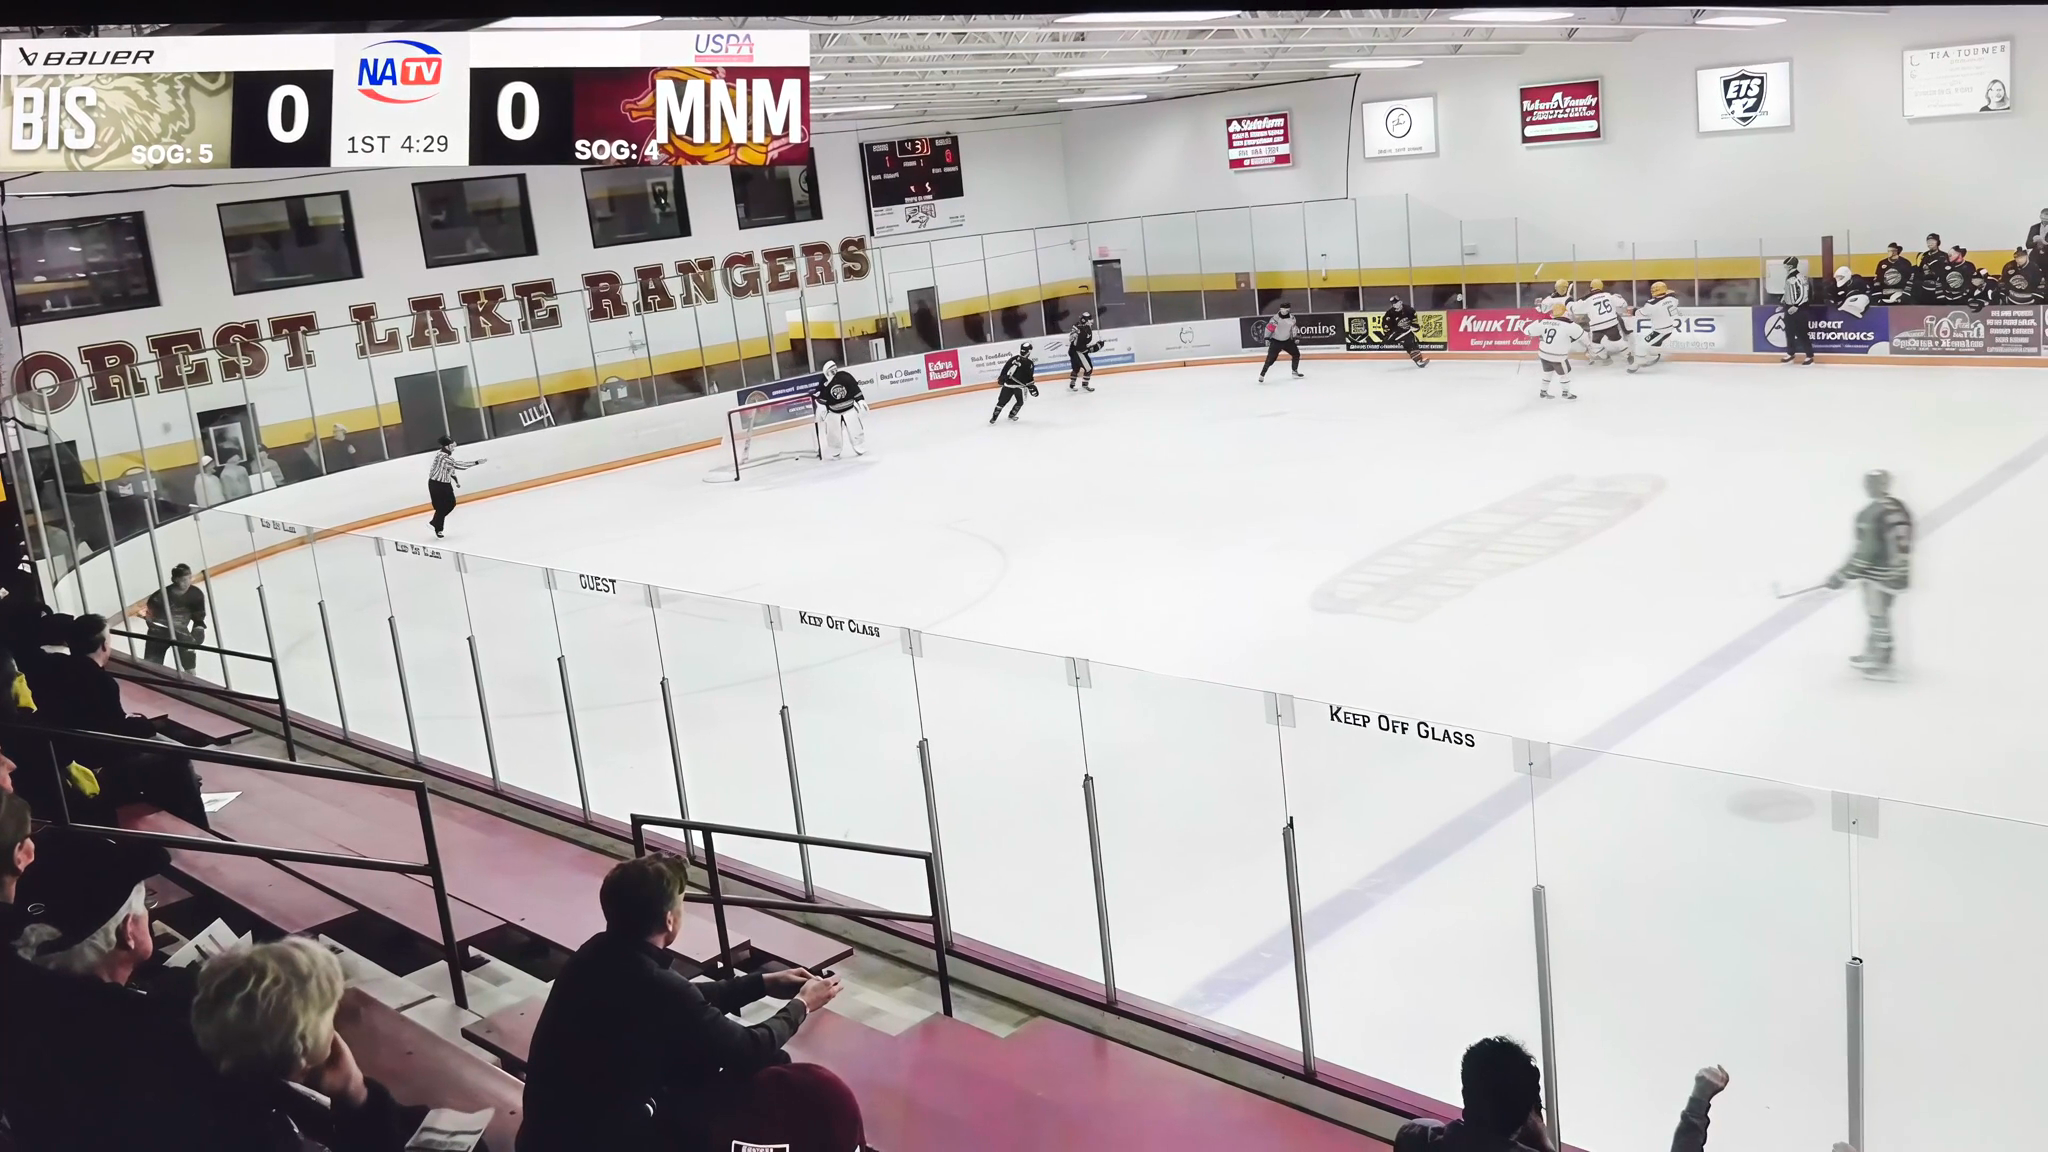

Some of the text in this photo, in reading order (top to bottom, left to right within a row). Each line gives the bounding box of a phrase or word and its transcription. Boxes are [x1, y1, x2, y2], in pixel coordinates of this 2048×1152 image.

[1725, 78, 1762, 99] ETS
[349, 278, 562, 359] LAKE
[581, 235, 872, 323] RANGERS
